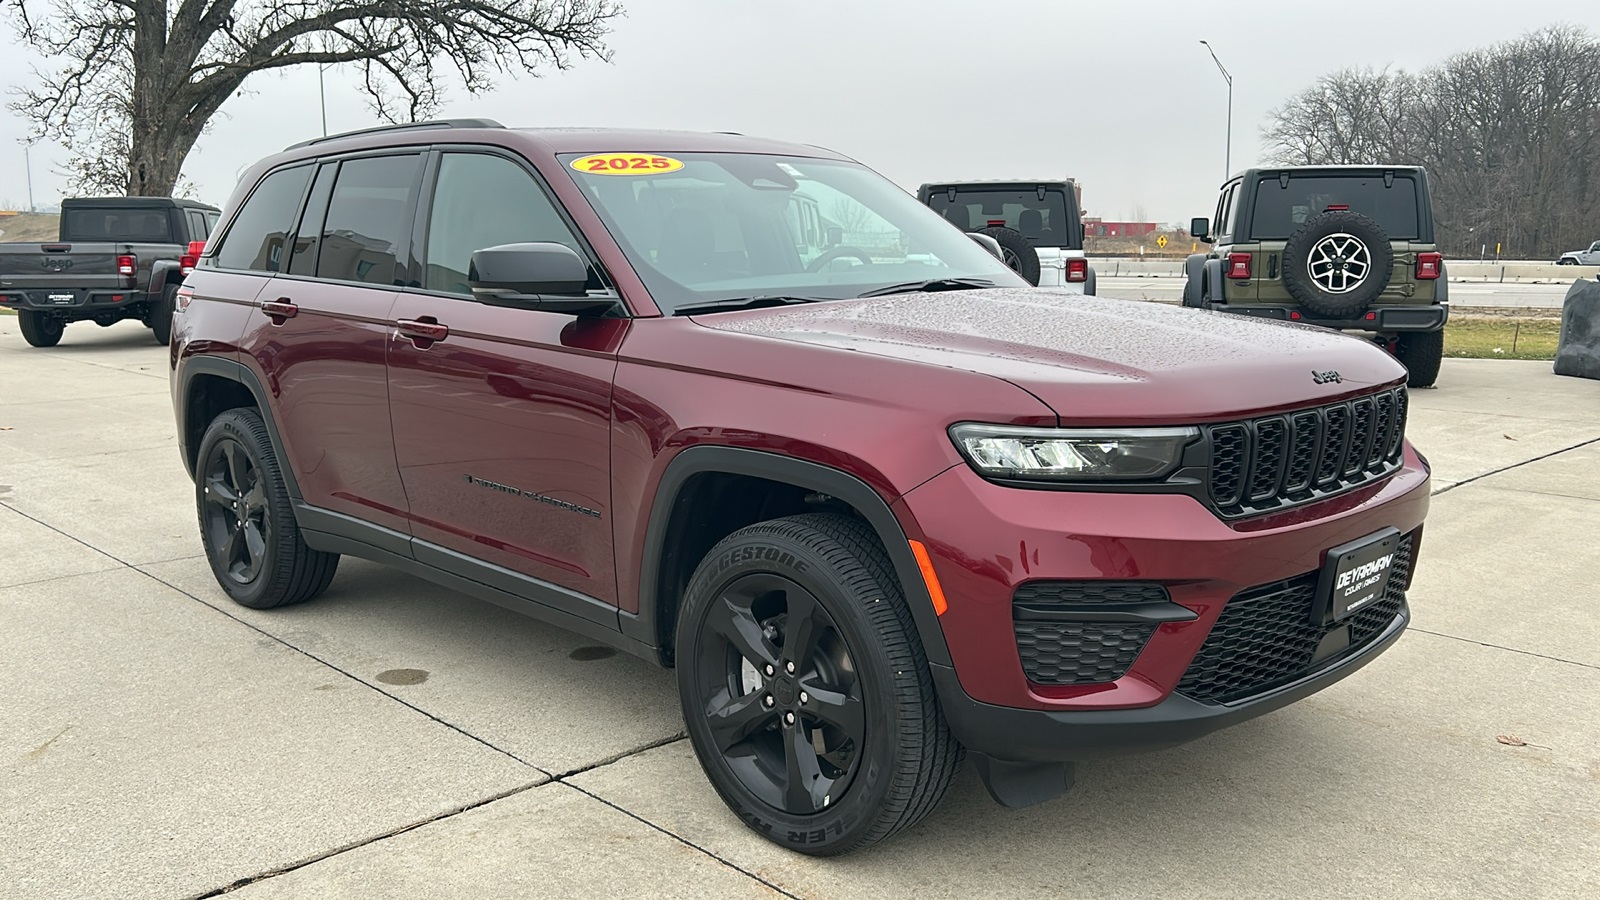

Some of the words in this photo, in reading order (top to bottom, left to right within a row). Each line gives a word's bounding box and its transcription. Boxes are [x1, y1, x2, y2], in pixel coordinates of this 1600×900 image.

[587, 158, 671, 171] 2025
[41, 257, 73, 270] Jeep
[1311, 370, 1343, 384] Jeep
[1336, 553, 1394, 590] DEYARMAN
